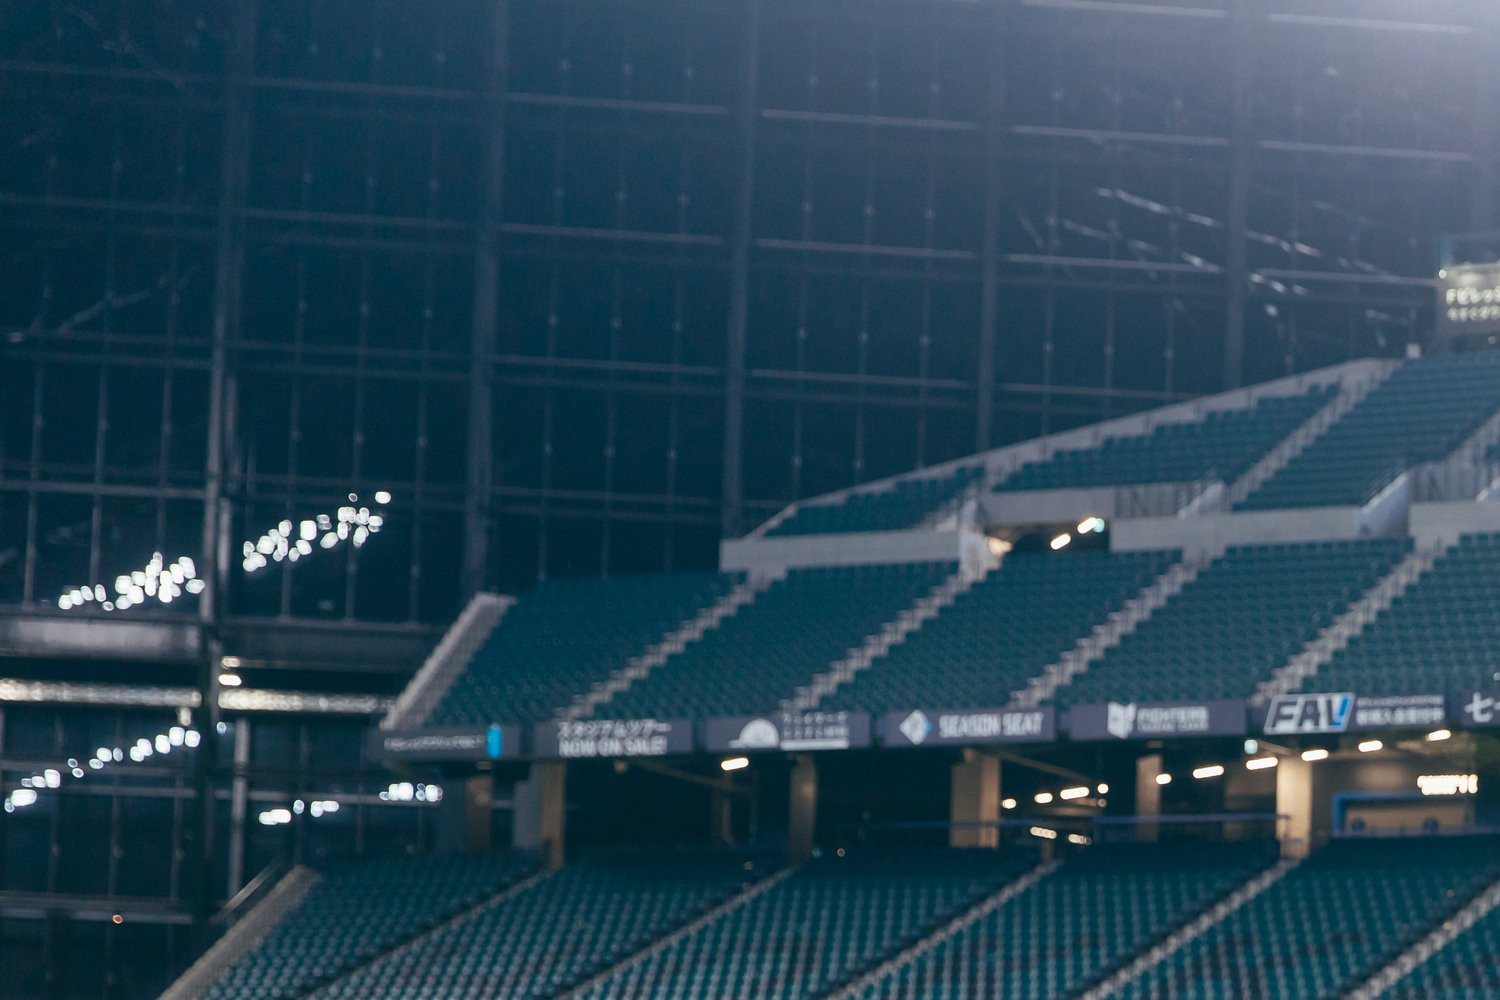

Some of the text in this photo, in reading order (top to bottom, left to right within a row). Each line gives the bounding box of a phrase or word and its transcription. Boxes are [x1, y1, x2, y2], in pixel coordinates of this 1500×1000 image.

[938, 711, 1044, 738] SEASON SEAT
[598, 736, 624, 756] ON
